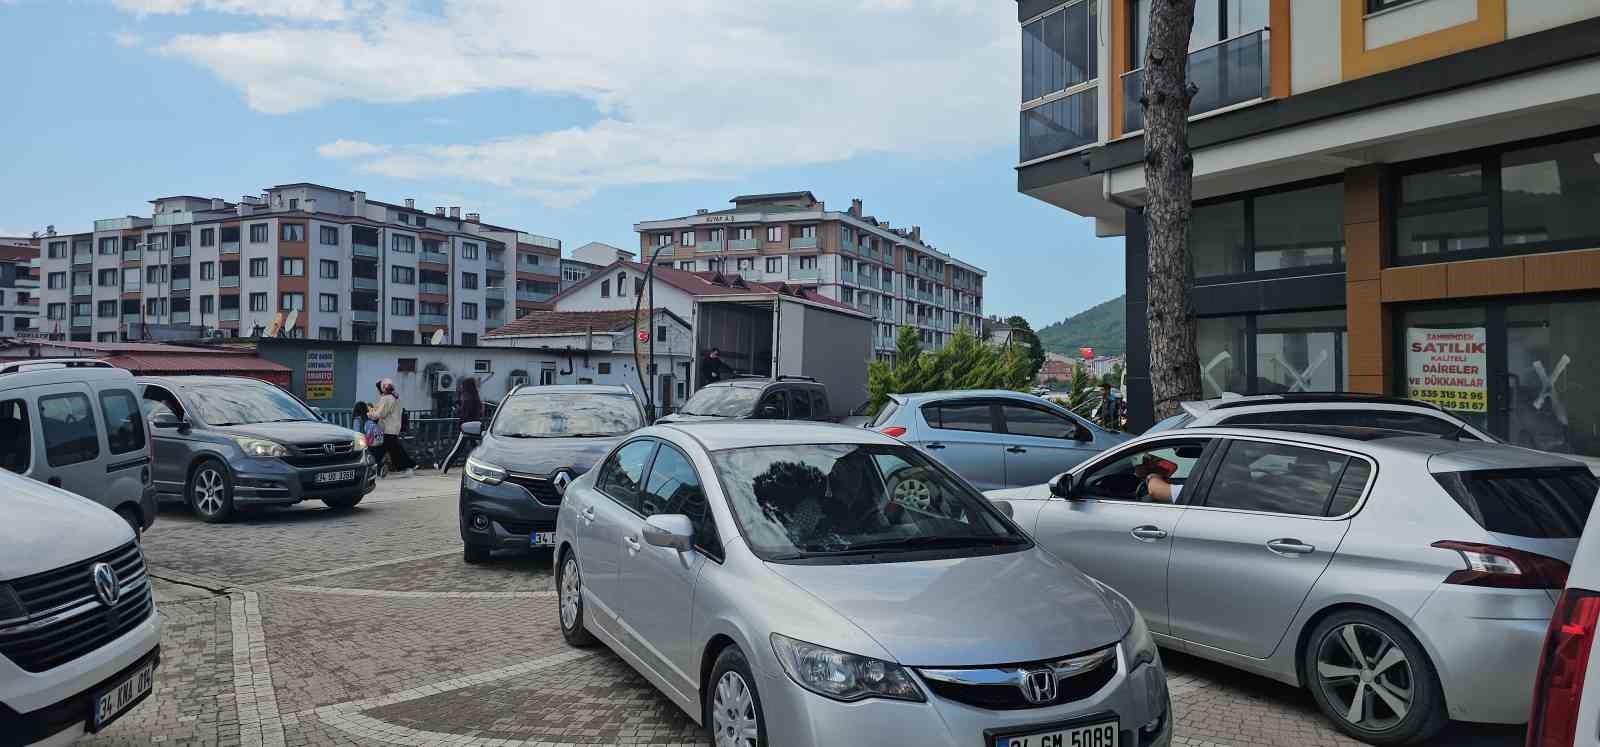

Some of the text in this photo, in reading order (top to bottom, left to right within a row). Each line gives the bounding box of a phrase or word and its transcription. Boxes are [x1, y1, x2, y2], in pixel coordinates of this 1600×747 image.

[1411, 342, 1485, 353] SATILIK
[1422, 363, 1479, 374] DAİRELER
[1409, 377, 1421, 385] VE
[100, 695, 112, 720] 34
